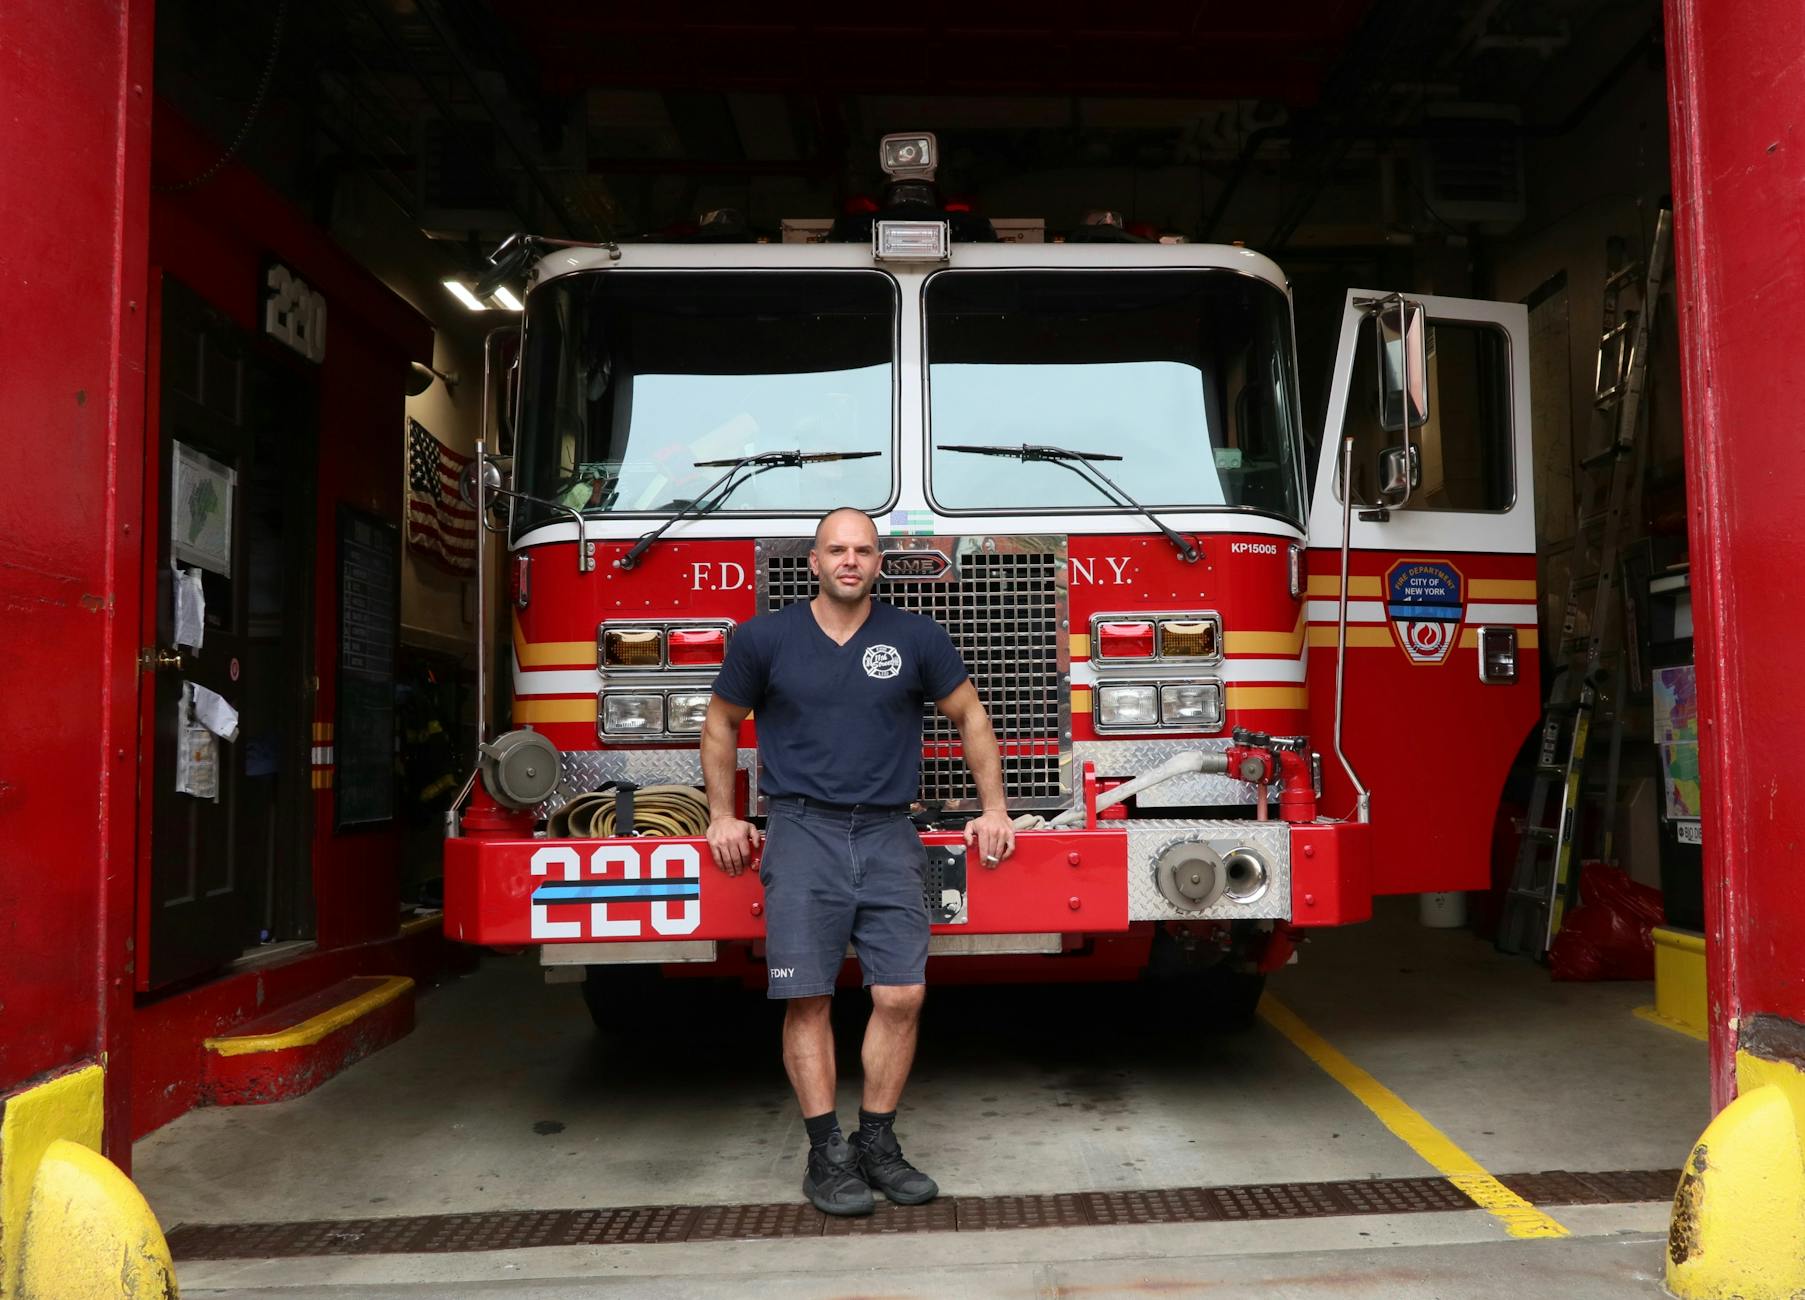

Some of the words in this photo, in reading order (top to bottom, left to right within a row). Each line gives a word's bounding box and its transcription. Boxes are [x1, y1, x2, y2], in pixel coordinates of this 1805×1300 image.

[1231, 542, 1277, 555] KP15005
[886, 559, 934, 570] KME
[1069, 556, 1132, 585] N.Y.
[691, 562, 753, 590] F.D.
[1395, 571, 1409, 590] FIRE
[1408, 566, 1455, 590] DEPARTMENT
[1410, 578, 1427, 586] CITY
[1404, 587, 1423, 595] NEW
[530, 844, 701, 939] 220
[769, 967, 795, 978] FDNY
